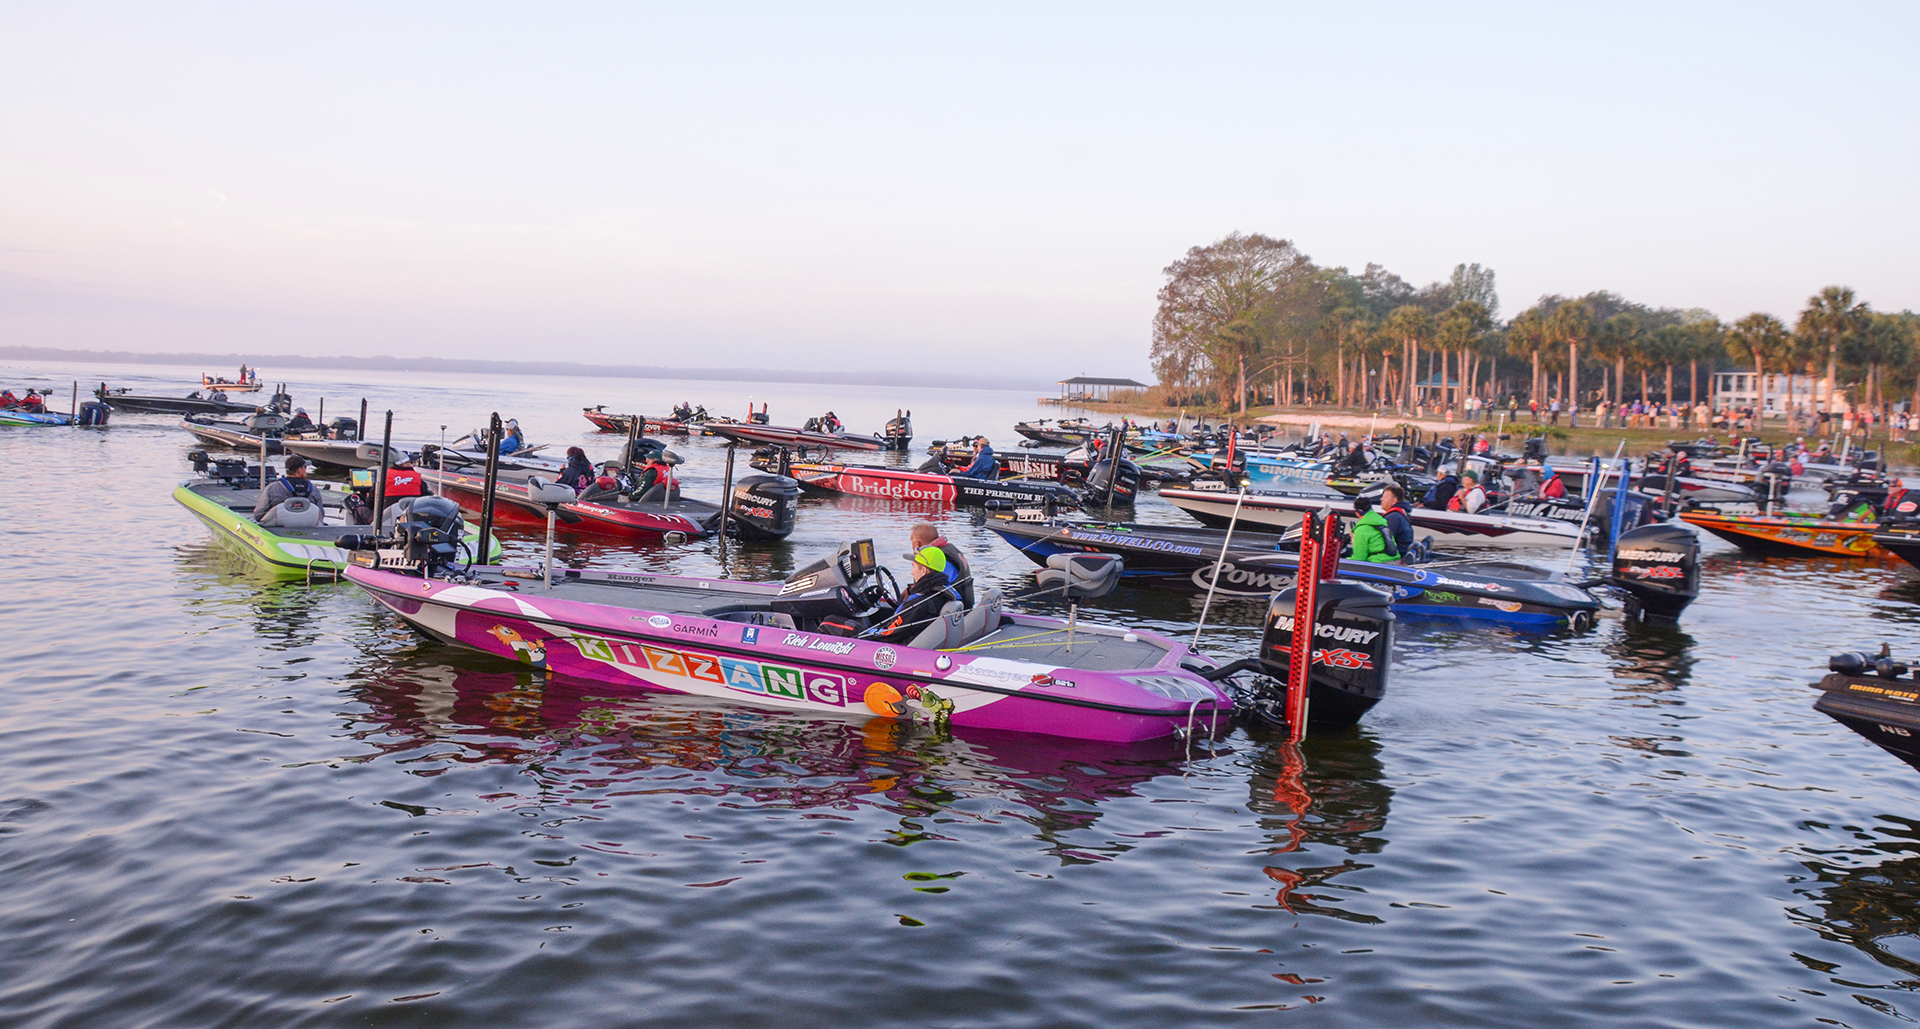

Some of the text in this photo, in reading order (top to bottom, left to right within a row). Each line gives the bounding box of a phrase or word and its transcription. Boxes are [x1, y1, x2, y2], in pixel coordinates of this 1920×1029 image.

[394, 475, 413, 486] Ranger
[850, 476, 944, 500] Bridgford
[734, 491, 777, 507] MERCURY
[963, 487, 984, 496] THE
[985, 489, 1034, 500] PREMIUM
[1071, 531, 1202, 555] www.POWELLCO.com
[1616, 550, 1686, 562] MERCURY
[607, 573, 656, 583] Ranger
[673, 624, 718, 637] GARMIN
[1274, 616, 1379, 645] MCURY
[782, 633, 808, 648] Rich
[582, 637, 840, 703] KIZZANG
[958, 664, 1032, 682] Ranger
[1878, 724, 1912, 737] NB
